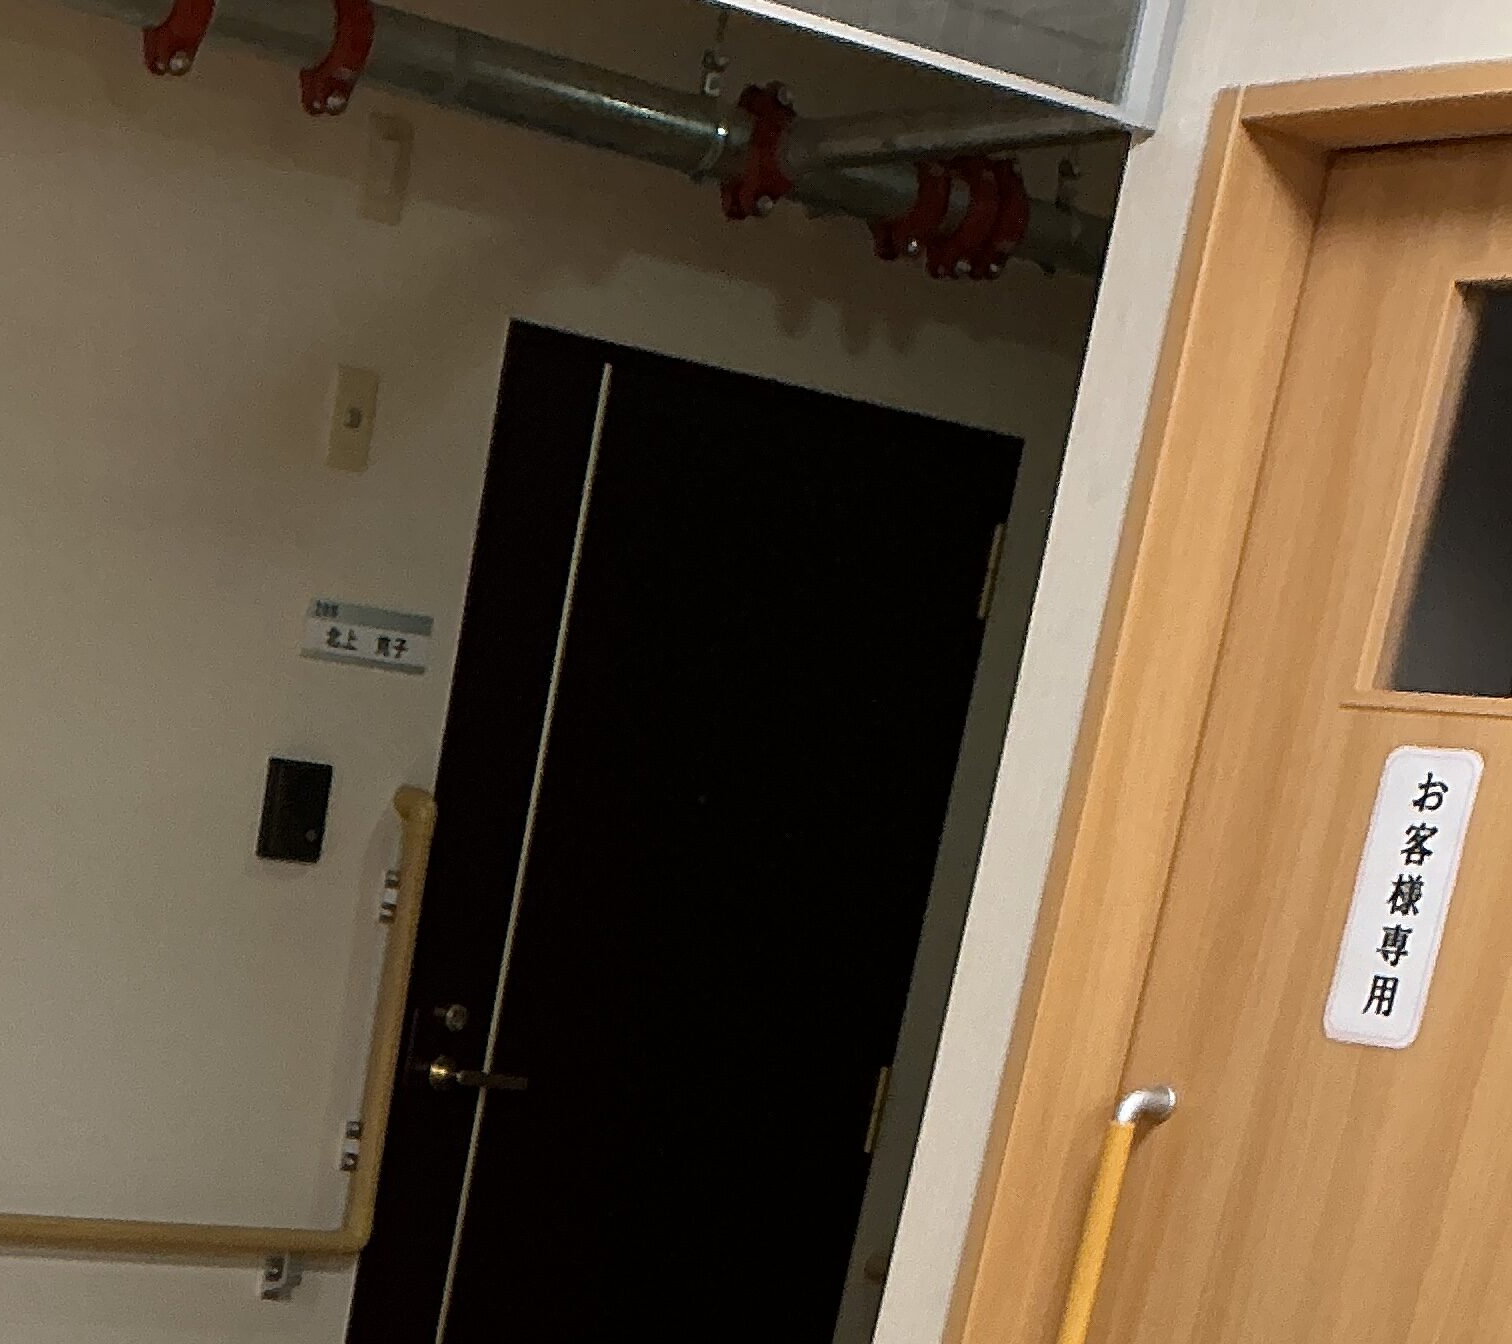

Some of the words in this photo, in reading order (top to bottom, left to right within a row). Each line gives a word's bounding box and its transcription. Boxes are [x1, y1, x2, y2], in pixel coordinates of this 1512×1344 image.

[1361, 771, 1449, 1017] お客様専用
